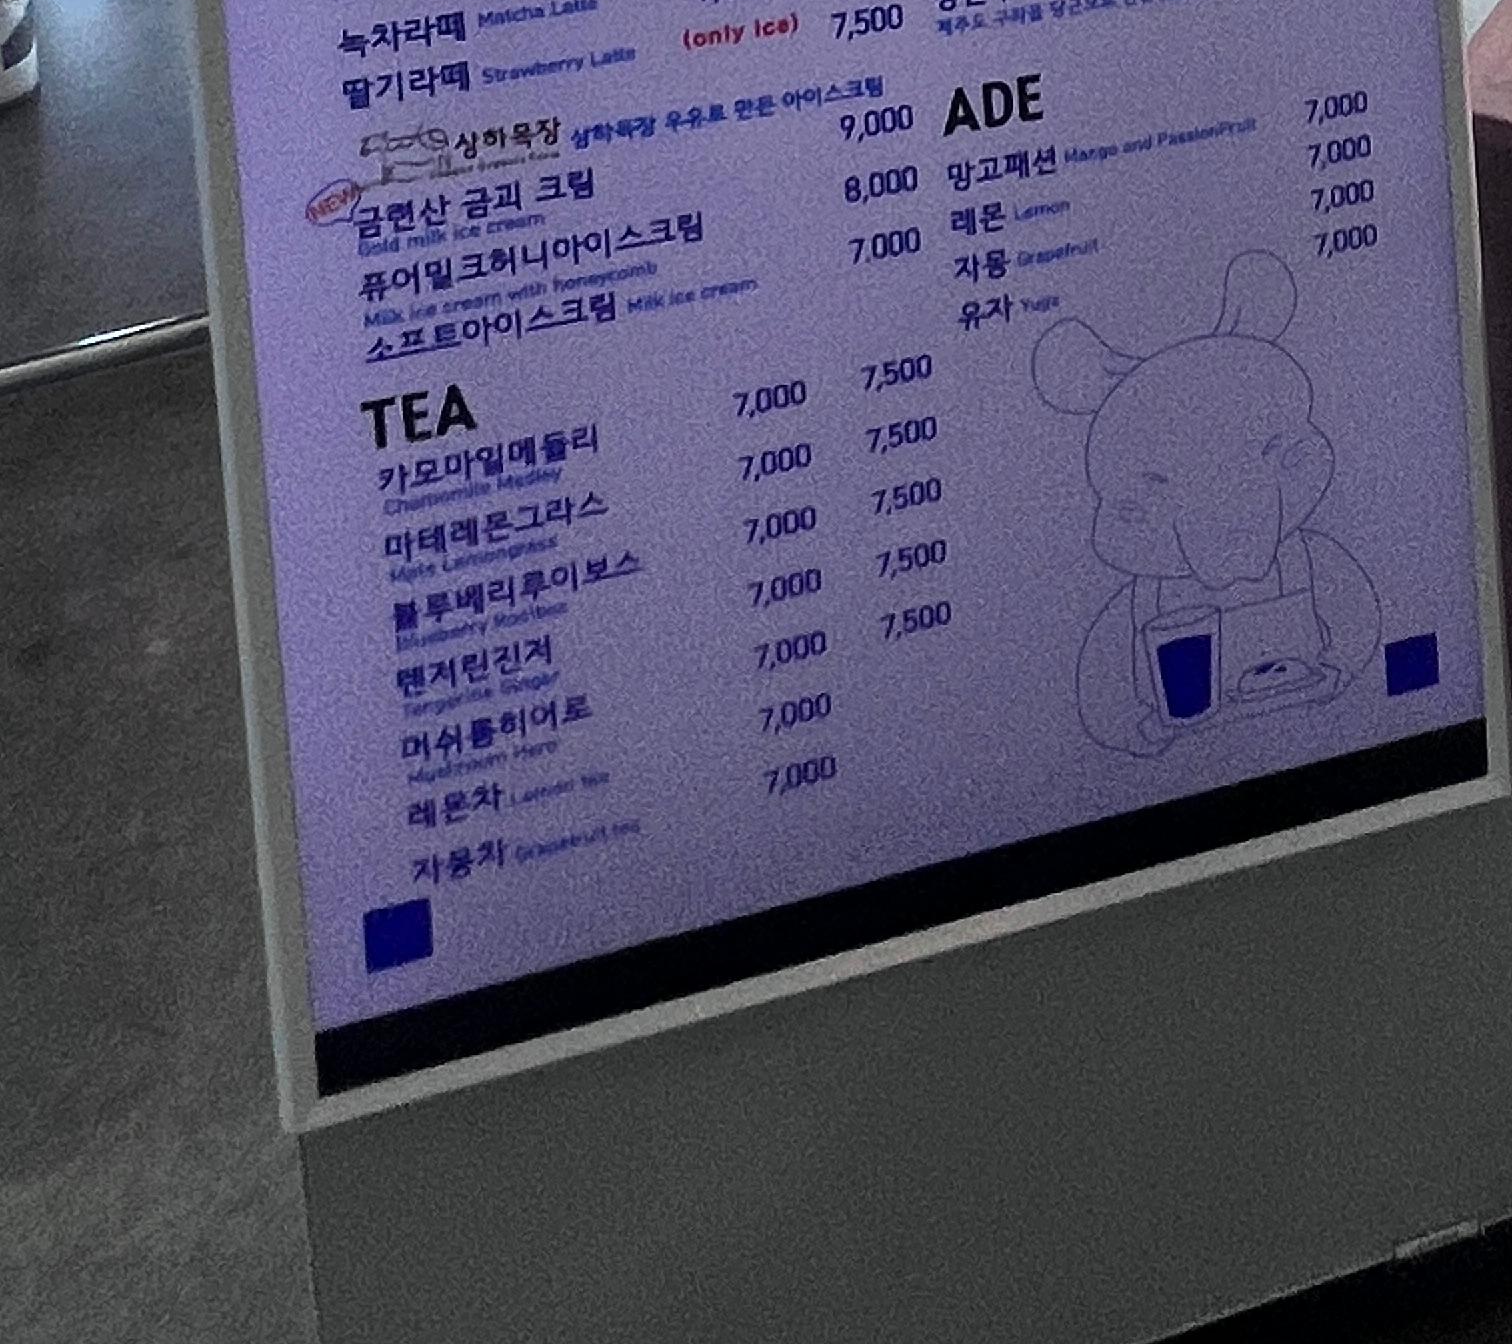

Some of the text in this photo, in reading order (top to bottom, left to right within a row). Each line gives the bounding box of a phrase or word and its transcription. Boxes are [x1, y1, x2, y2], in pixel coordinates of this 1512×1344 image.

[338, 11, 466, 58] 녹차라떼
[682, 24, 745, 51] (only
[831, 3, 903, 41] 7,500
[342, 60, 470, 110] 딸기라떼
[782, 75, 884, 112] 아이스크림
[943, 72, 1044, 138] ADE
[1304, 90, 1368, 125] 7,000
[453, 115, 561, 160] 상하목장
[840, 104, 914, 144] 9,000
[946, 145, 1056, 192] 망고패션
[1308, 134, 1372, 169] 7,000
[461, 179, 522, 220] 금괴
[535, 166, 593, 200] 크림
[844, 165, 918, 205] 8,000
[1311, 179, 1375, 214] 7,000
[950, 202, 1007, 236] 레몬
[1314, 224, 1378, 258] 7,000
[358, 210, 703, 302] 퓨어밀크허니아이스크림
[848, 226, 921, 265] 7,000
[954, 250, 1010, 283] 자몽
[365, 291, 615, 364] 소프트아이스크림
[957, 293, 1013, 331] 유자
[732, 353, 932, 418] 7,000 7,500
[360, 383, 478, 450] TEA
[378, 423, 599, 496] 카모마일메들리
[738, 416, 937, 482] 7,000 7,500
[384, 491, 609, 563] 마테레몬그라스
[742, 477, 942, 545] 7,000 7,500
[394, 550, 643, 633] 블루베리루이보스
[748, 538, 946, 609] 7,000 7,500
[753, 601, 951, 671] 7,000 7,500
[758, 692, 832, 735] 7,000
[763, 754, 837, 796] 7,000
[407, 782, 504, 829] 레몬차
[412, 837, 508, 885] 자몽차
